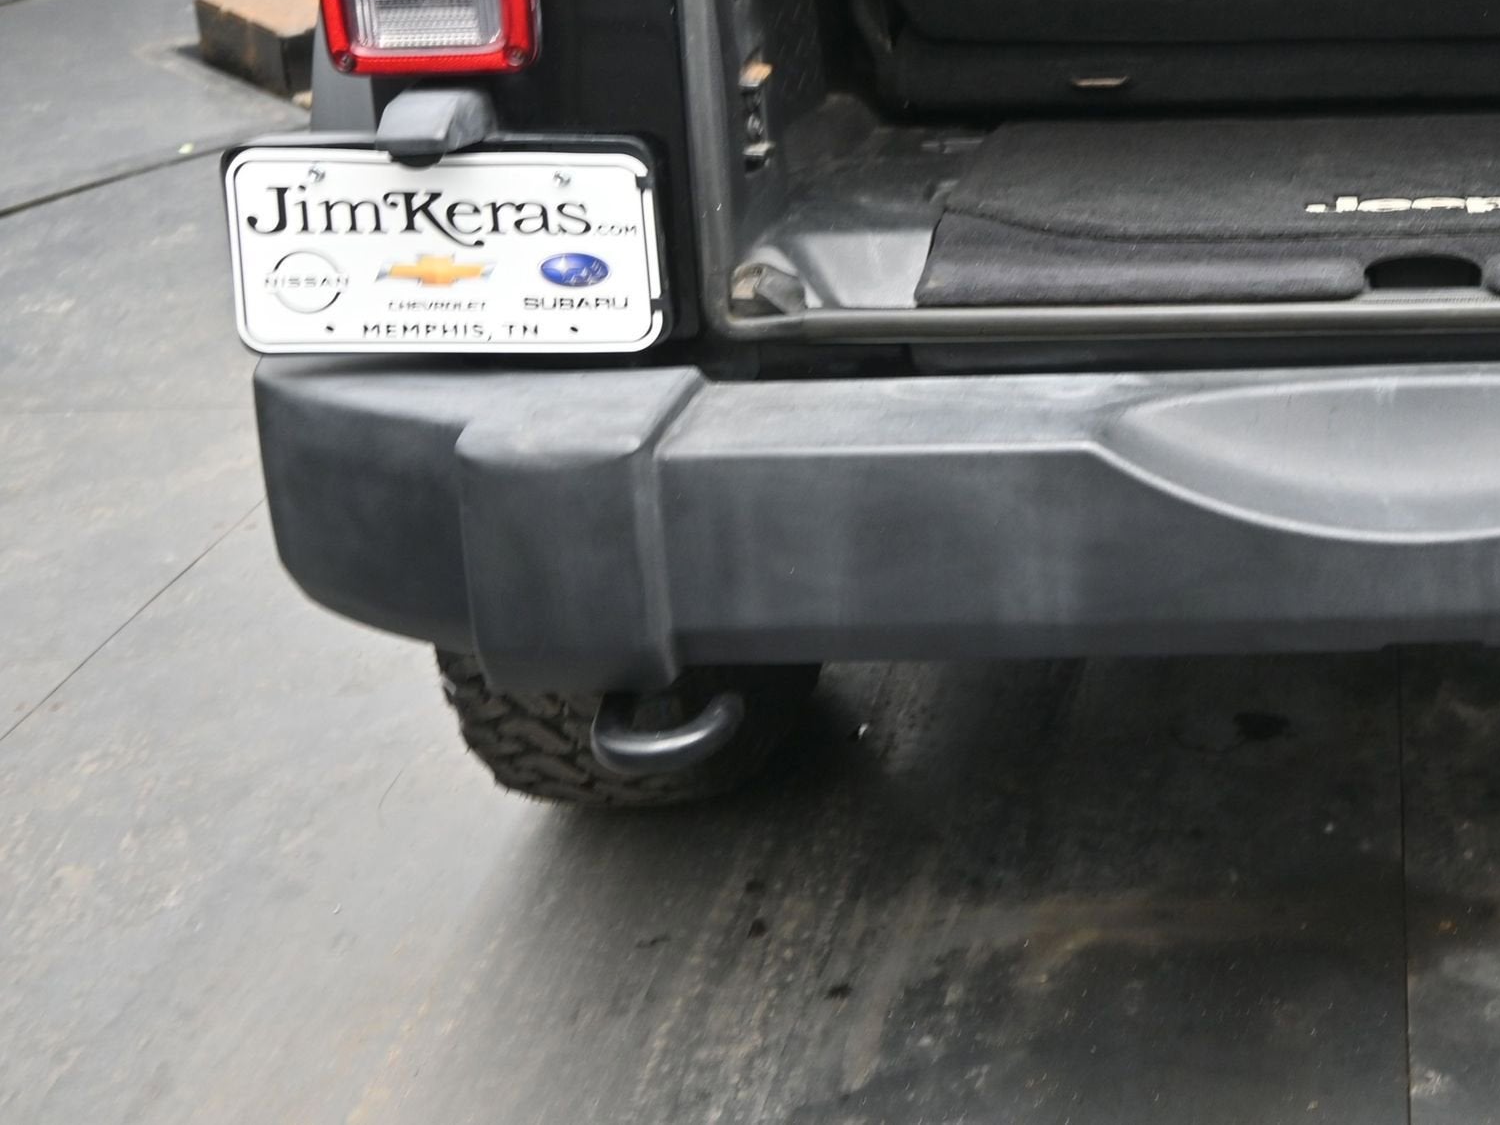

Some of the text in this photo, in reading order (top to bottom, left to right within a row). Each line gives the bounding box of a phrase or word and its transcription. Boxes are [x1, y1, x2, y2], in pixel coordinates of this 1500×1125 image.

[264, 276, 349, 289] NISSAN
[388, 300, 487, 311] CHEVROLET
[523, 297, 629, 311] SUBARU
[363, 324, 538, 342] MEMPHIS, TN
